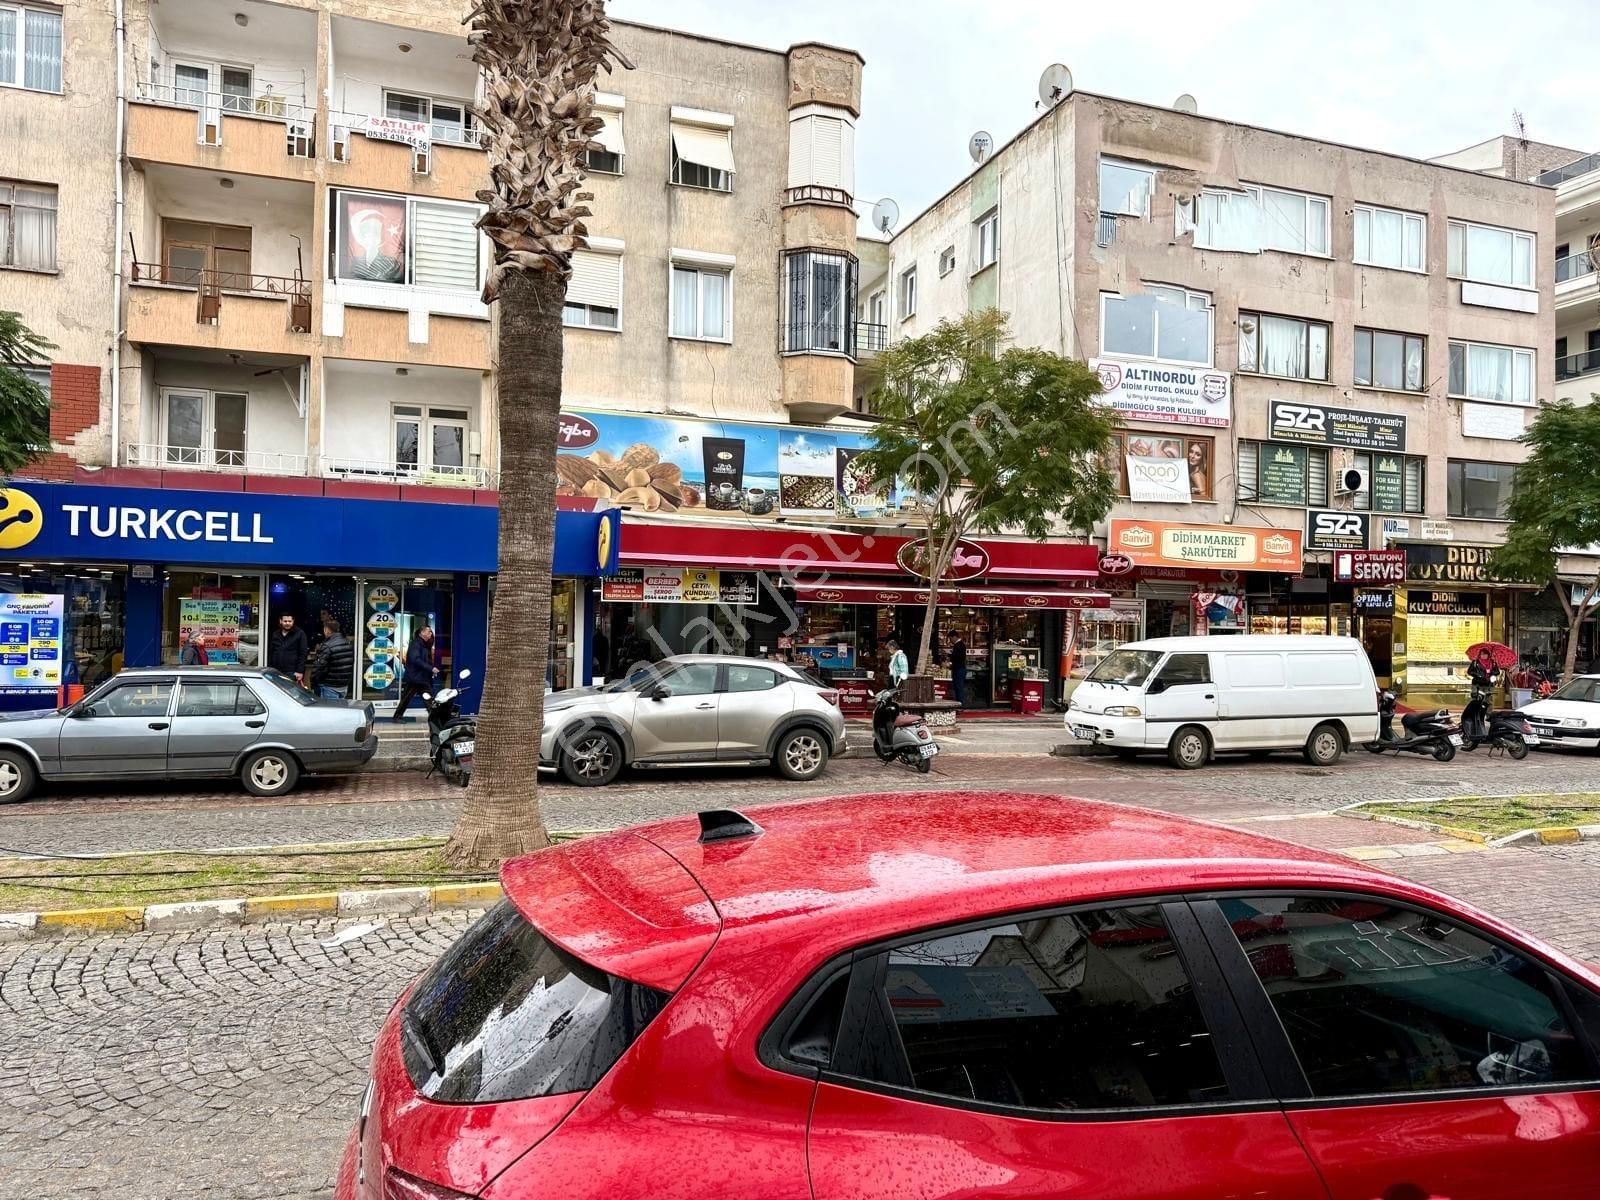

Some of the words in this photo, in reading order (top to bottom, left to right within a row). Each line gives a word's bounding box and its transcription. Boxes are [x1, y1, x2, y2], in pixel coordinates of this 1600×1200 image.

[371, 117, 425, 132] SATILIK
[418, 140, 428, 150] 56
[1126, 368, 1196, 386] ALTINORDU
[1144, 384, 1173, 394] FUTBOL
[1175, 387, 1199, 396] OKULU
[1157, 405, 1176, 413] SPOR
[1274, 404, 1326, 431] SZR
[62, 504, 275, 544] TURKCELL
[1316, 513, 1362, 536] SZR
[1383, 519, 1398, 533] NUR
[1122, 532, 1150, 545] Banvit
[1172, 531, 1201, 544] DİDİM
[1204, 534, 1247, 548] MARKET
[1181, 545, 1238, 560] ŞARKÜTERİ
[1265, 540, 1290, 554] Banvit
[1354, 553, 1367, 561] CEP
[1369, 554, 1402, 562] TELEFONU
[1354, 562, 1404, 580] SERVİS
[648, 578, 679, 586] BERBER
[377, 589, 388, 597] 10
[685, 590, 717, 598] KUNDURA
[376, 614, 389, 622] 20
